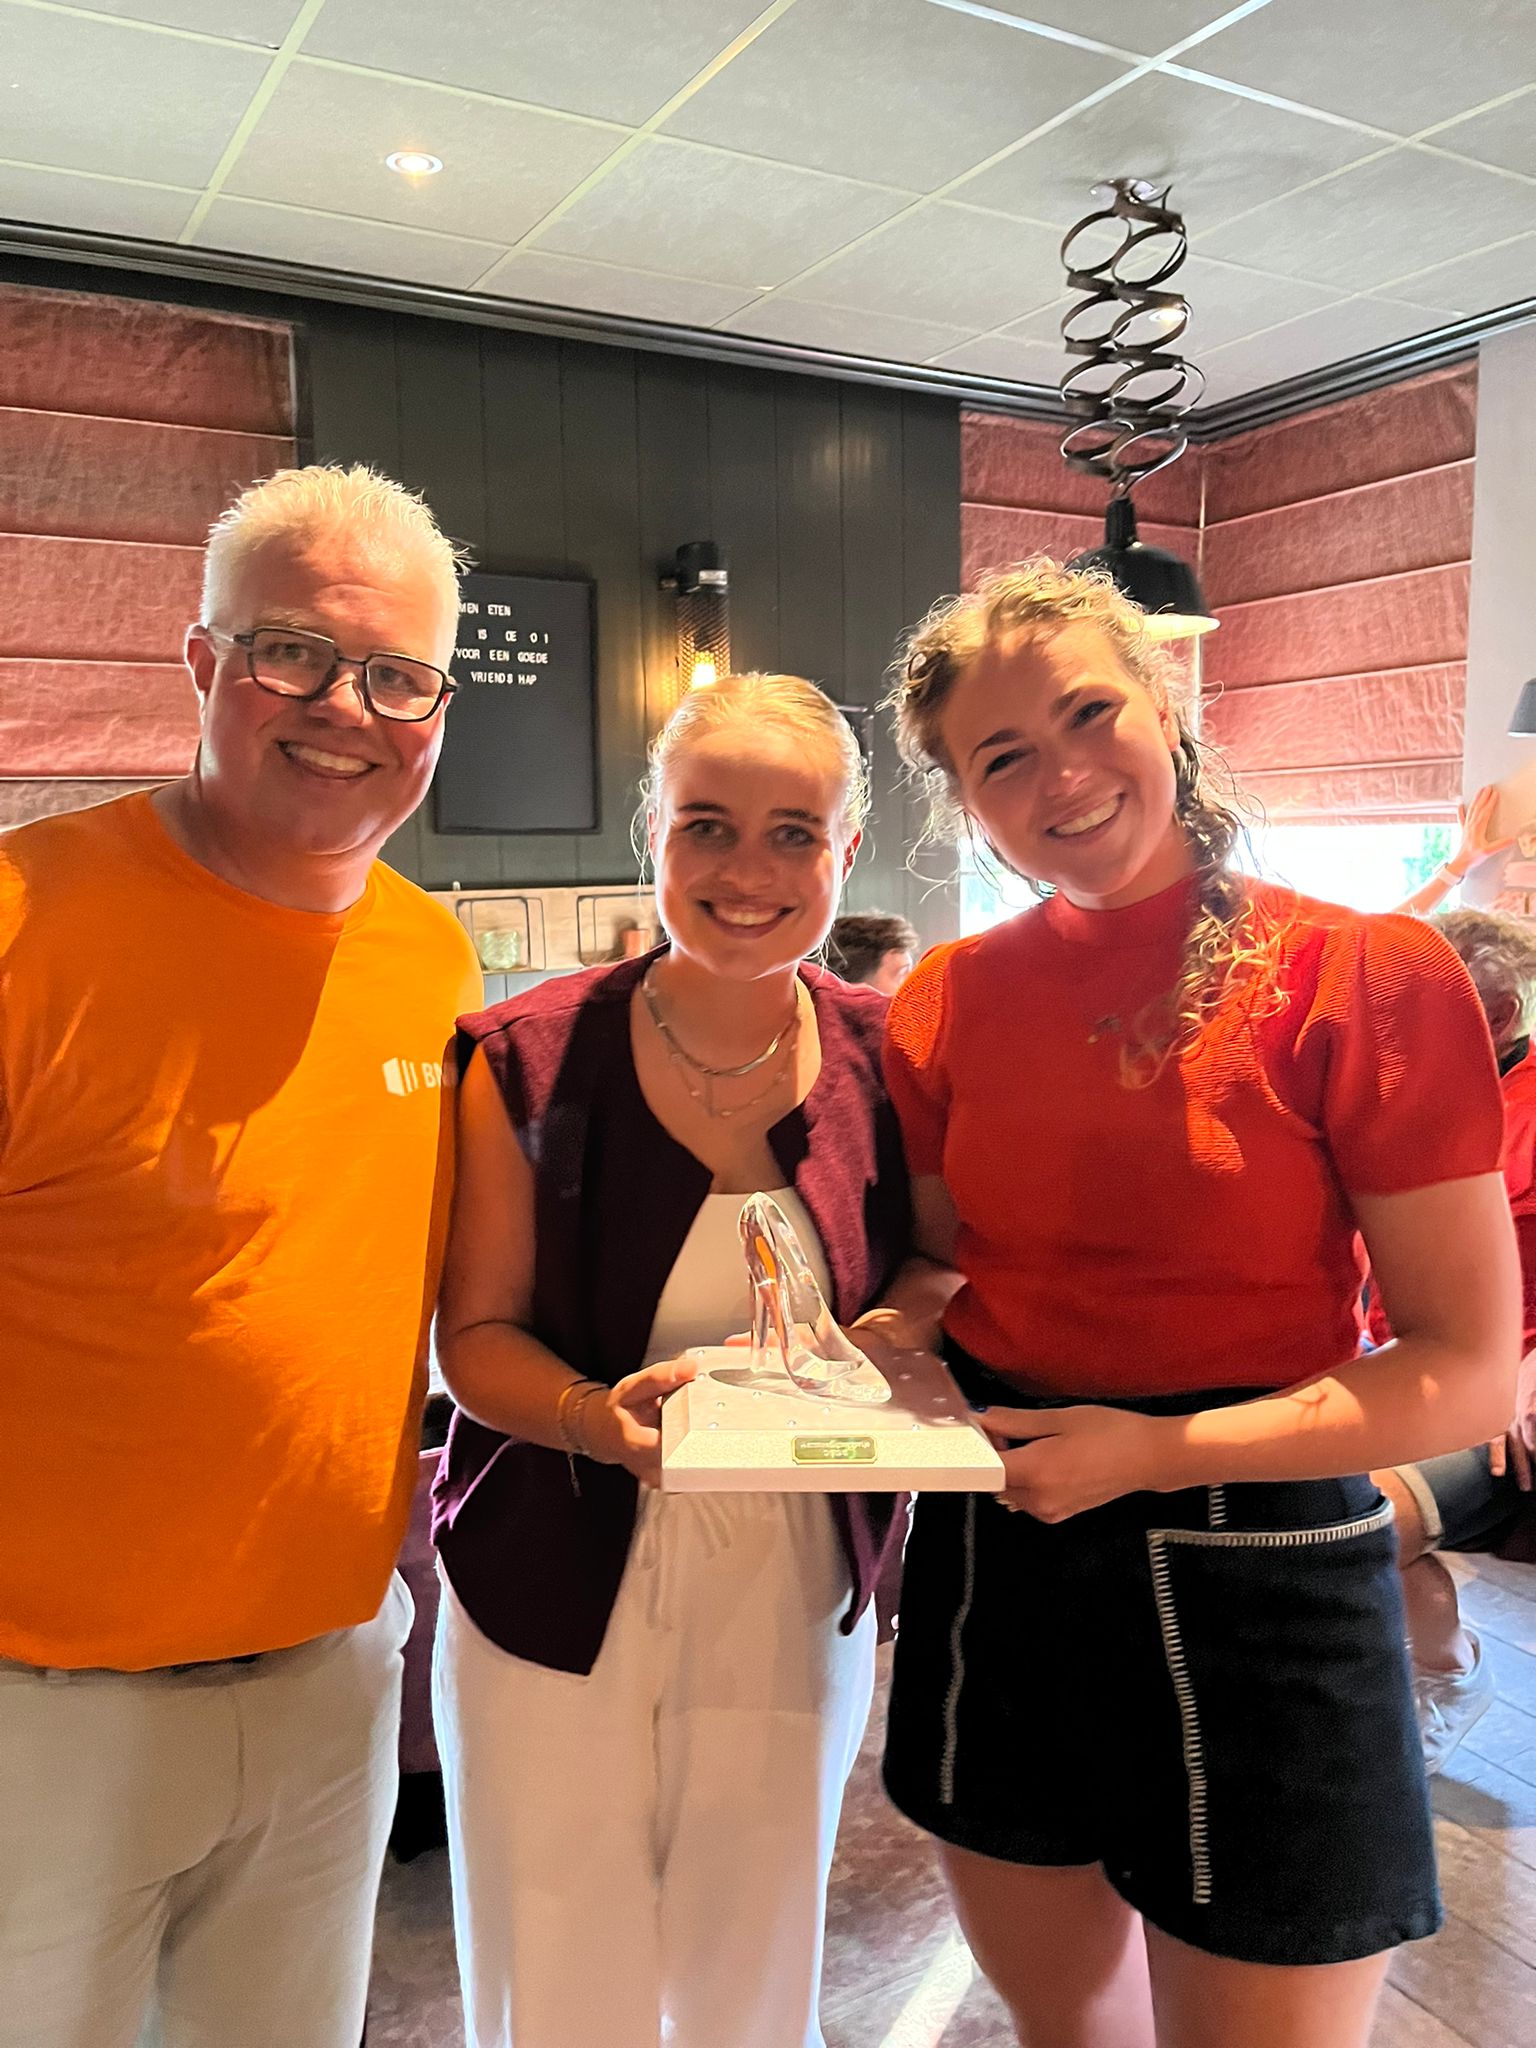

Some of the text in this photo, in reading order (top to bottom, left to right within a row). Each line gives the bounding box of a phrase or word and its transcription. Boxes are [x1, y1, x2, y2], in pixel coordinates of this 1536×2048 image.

[488, 604, 511, 616] ETEN
[455, 648, 548, 664] VOOR EEN GOEDE
